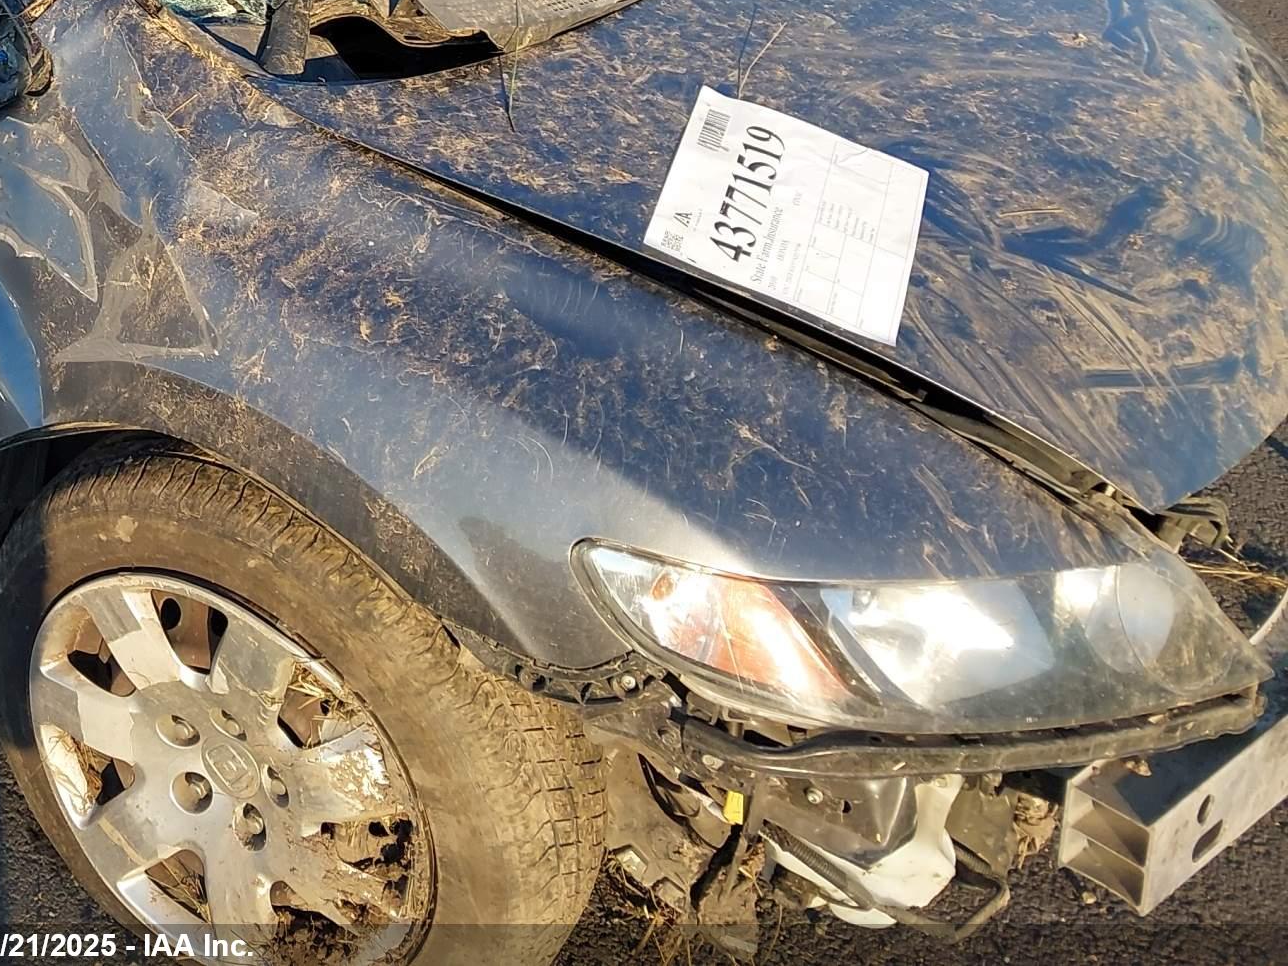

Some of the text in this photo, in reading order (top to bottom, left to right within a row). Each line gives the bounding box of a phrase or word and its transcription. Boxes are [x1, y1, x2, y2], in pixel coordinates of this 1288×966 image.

[710, 125, 785, 263] 43771519
[750, 206, 784, 284] State Farm Insurance
